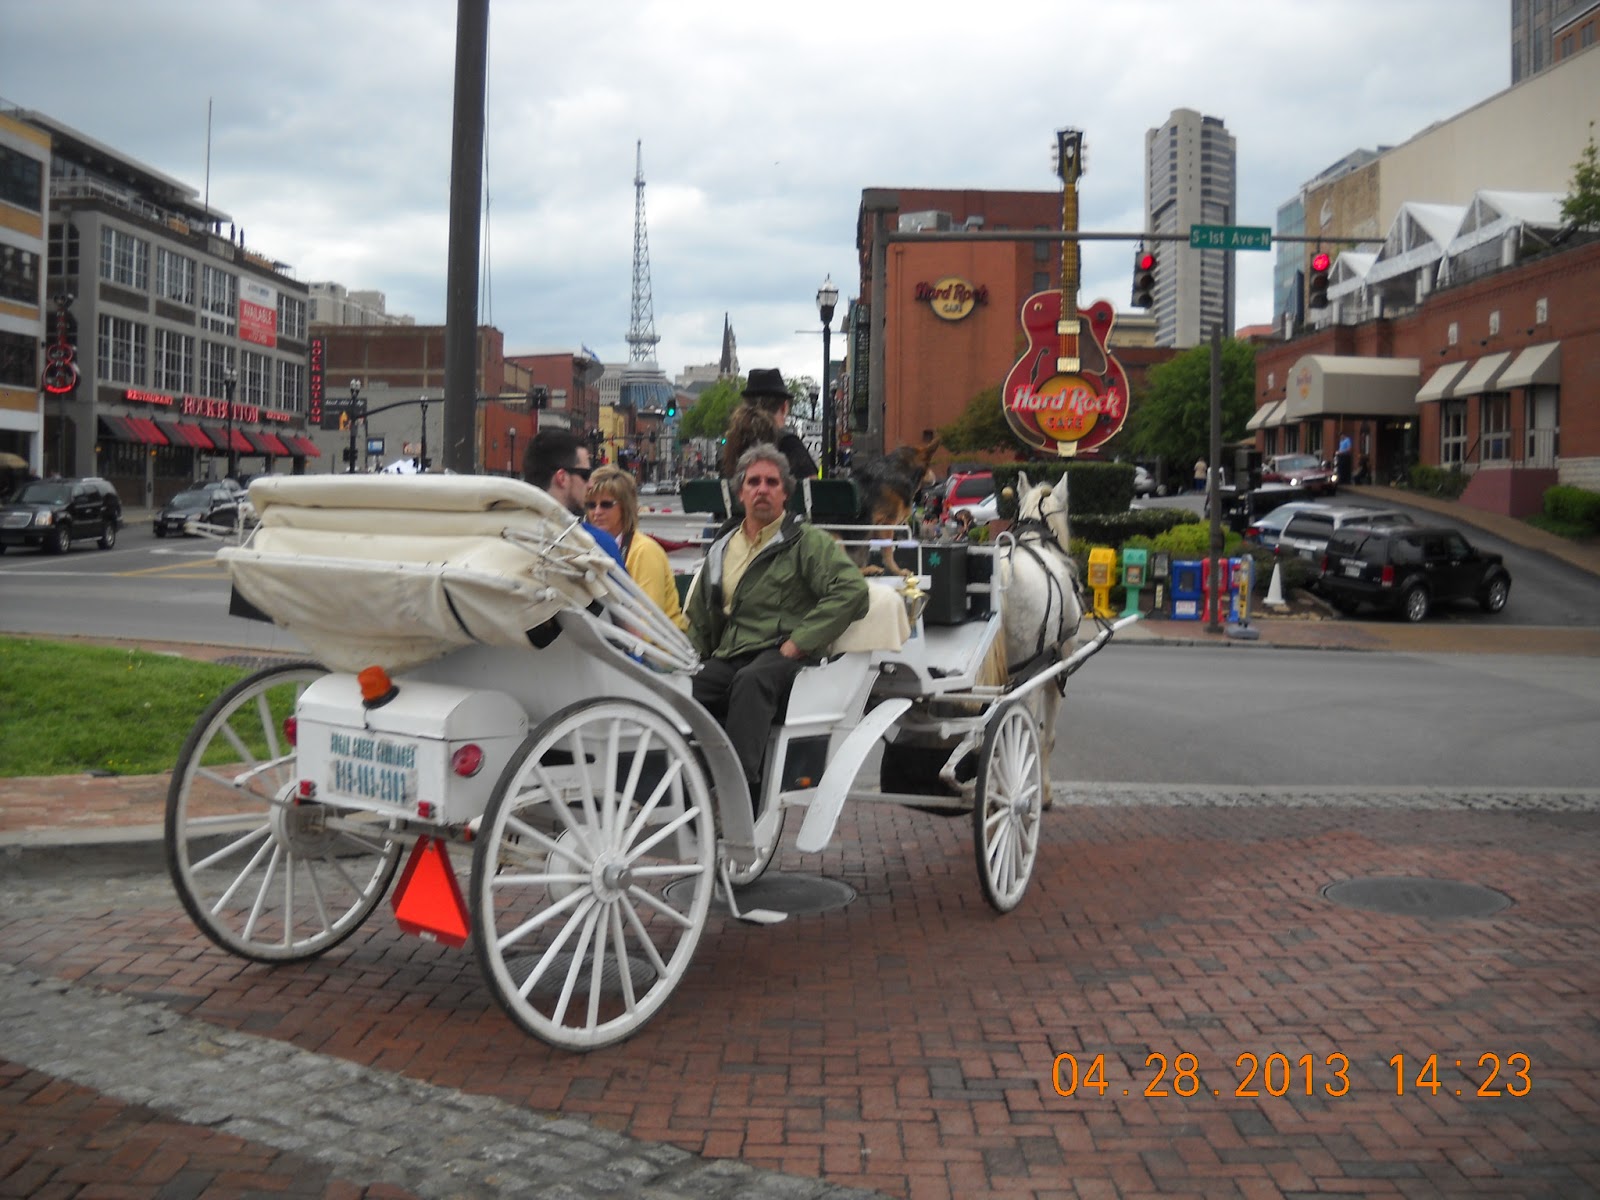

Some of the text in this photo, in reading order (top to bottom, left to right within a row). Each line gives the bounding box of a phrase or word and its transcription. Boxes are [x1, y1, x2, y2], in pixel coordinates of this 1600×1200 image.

[915, 282, 989, 306] Hard Rock
[311, 339, 322, 372] ROCK
[183, 396, 215, 417] ROCK
[311, 374, 321, 423] BOTTOM
[1011, 385, 1121, 417] Hard Rock
[1046, 416, 1084, 430] CAFE
